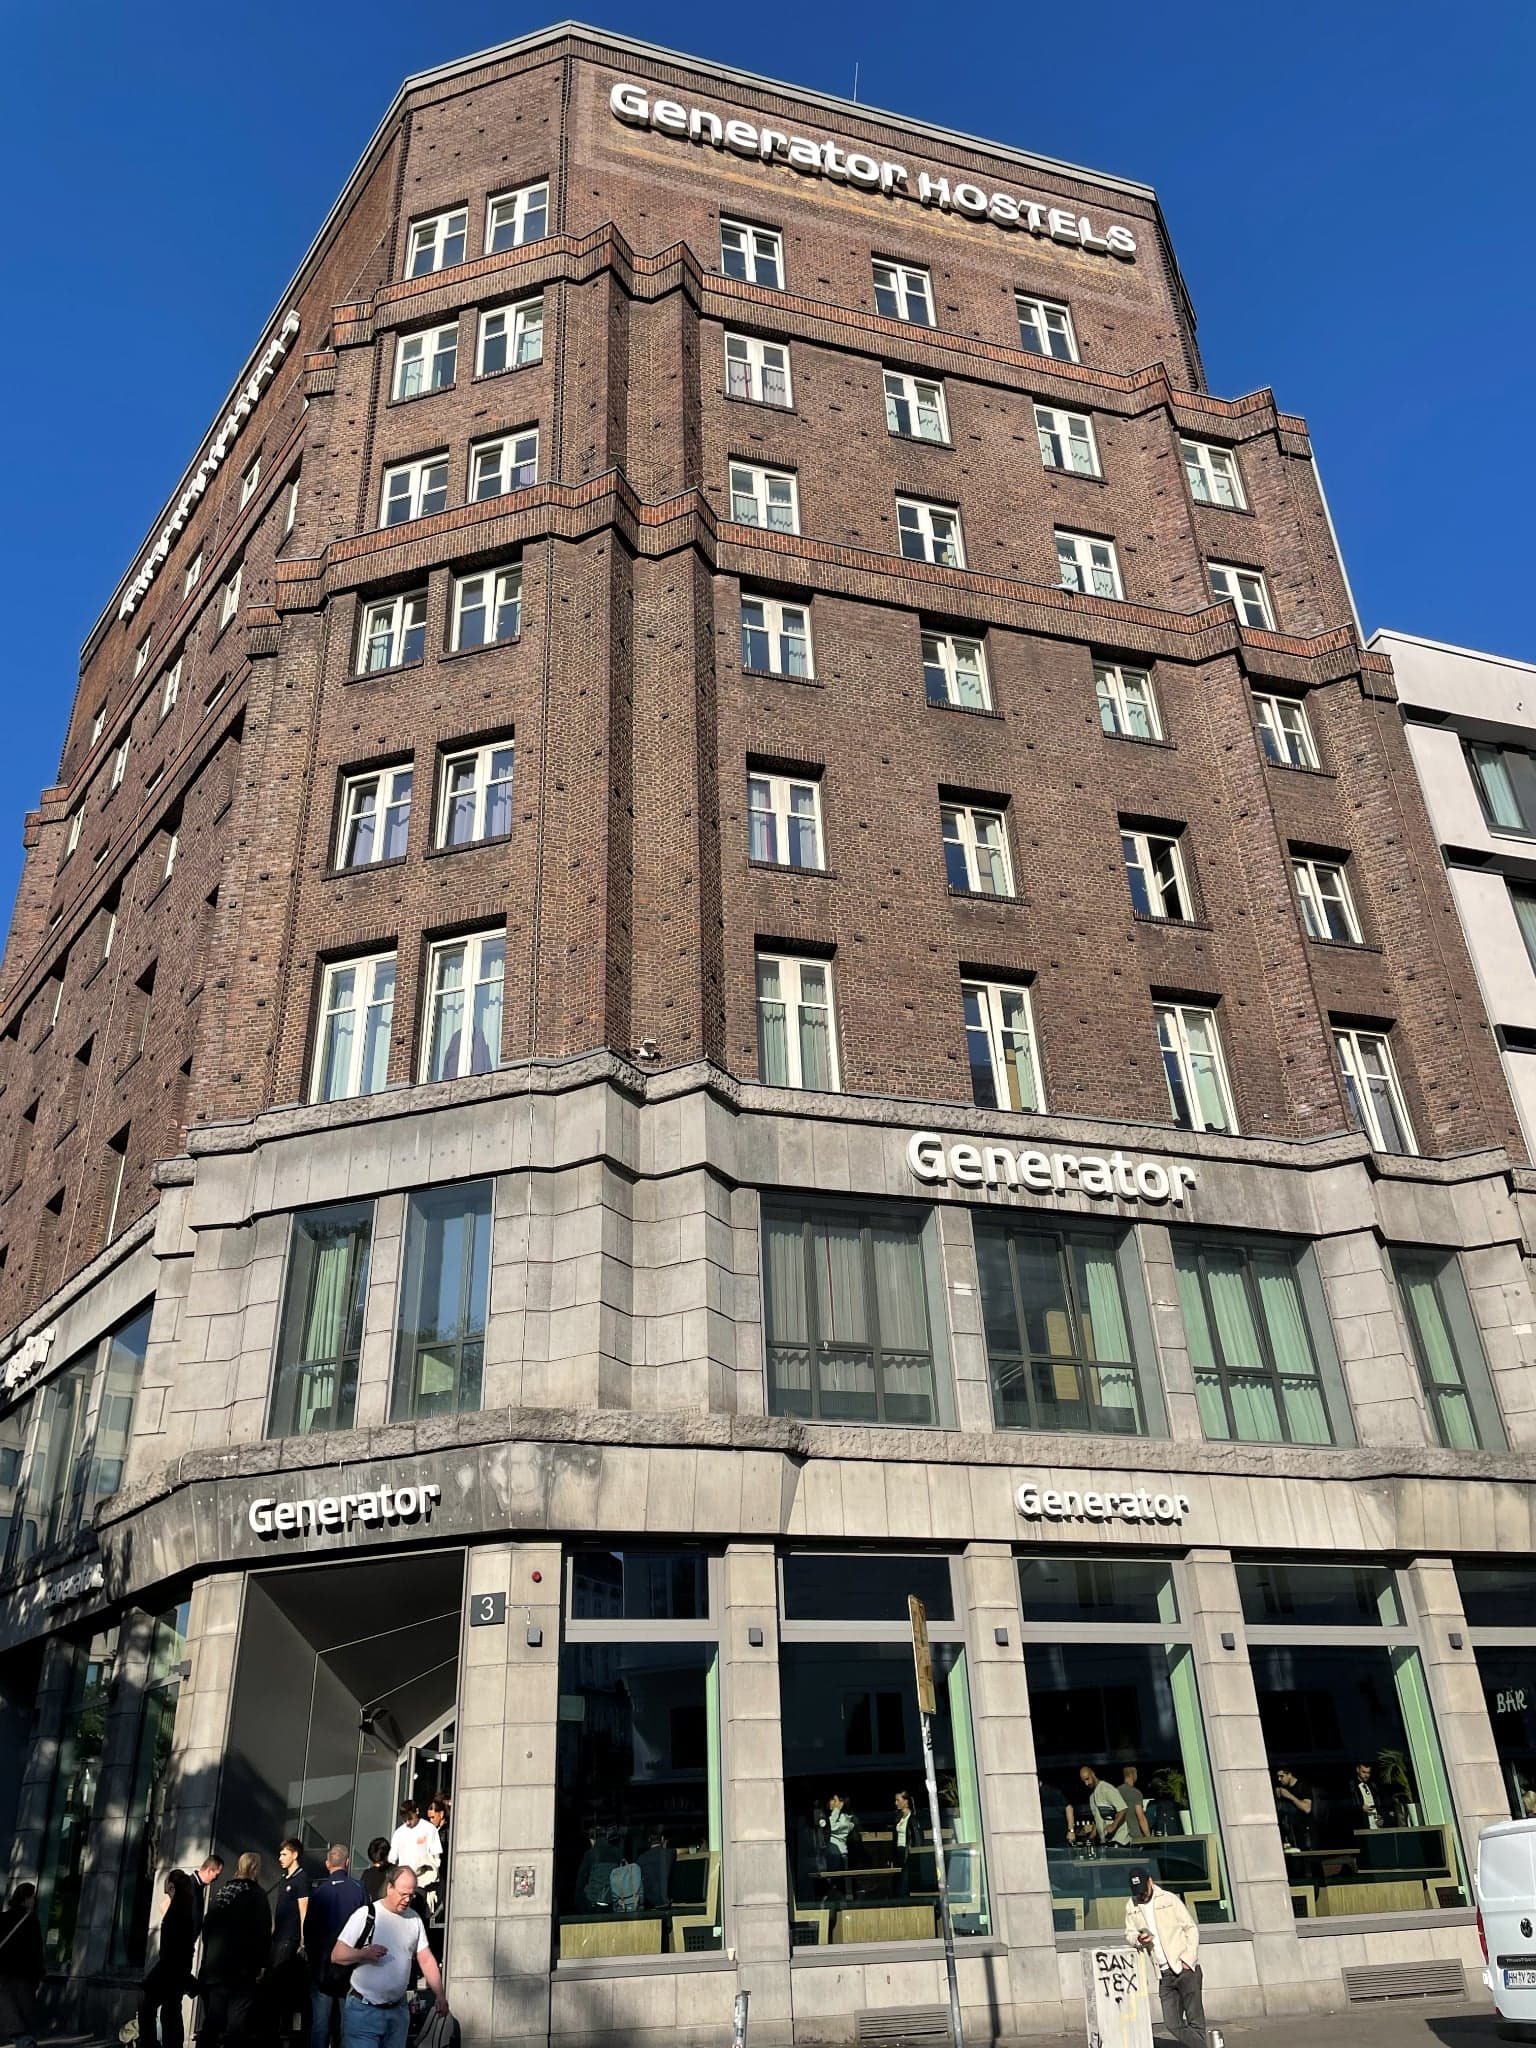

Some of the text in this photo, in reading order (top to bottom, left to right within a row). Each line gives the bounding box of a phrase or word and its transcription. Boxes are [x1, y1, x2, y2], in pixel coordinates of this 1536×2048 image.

[609, 83, 1137, 258] Generator HOSTELS
[906, 1131, 1196, 1201] Generator
[249, 1483, 441, 1533] Generator
[1016, 1482, 1190, 1521] Generator
[480, 1596, 494, 1621] 3
[1098, 1973, 1138, 1997] TEX
